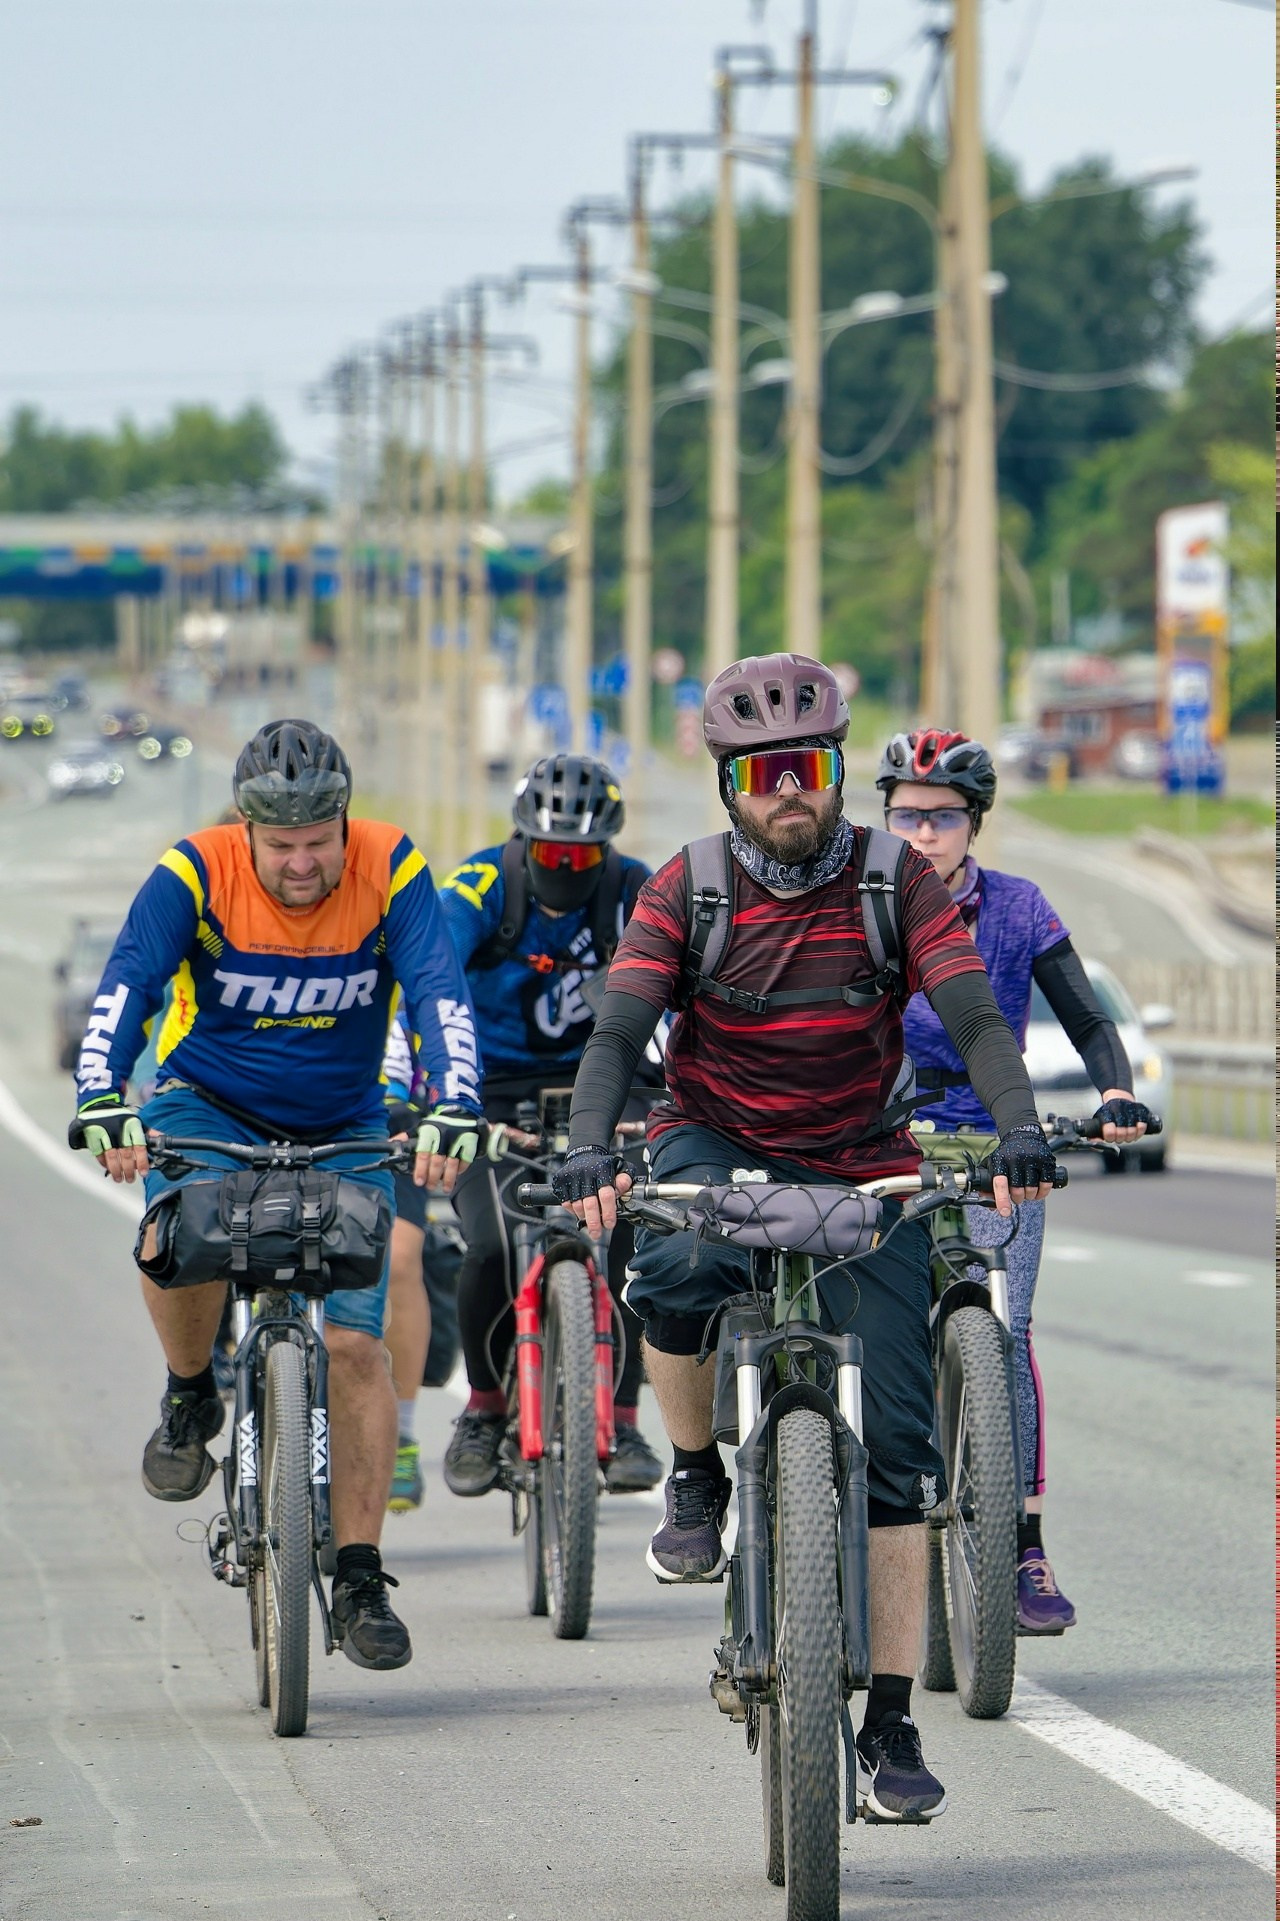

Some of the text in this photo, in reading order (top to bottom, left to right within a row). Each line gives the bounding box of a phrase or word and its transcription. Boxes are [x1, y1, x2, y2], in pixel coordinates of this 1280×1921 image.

[213, 968, 379, 1014] THOR
[77, 983, 130, 1094] THOR
[253, 1015, 338, 1031] RACING
